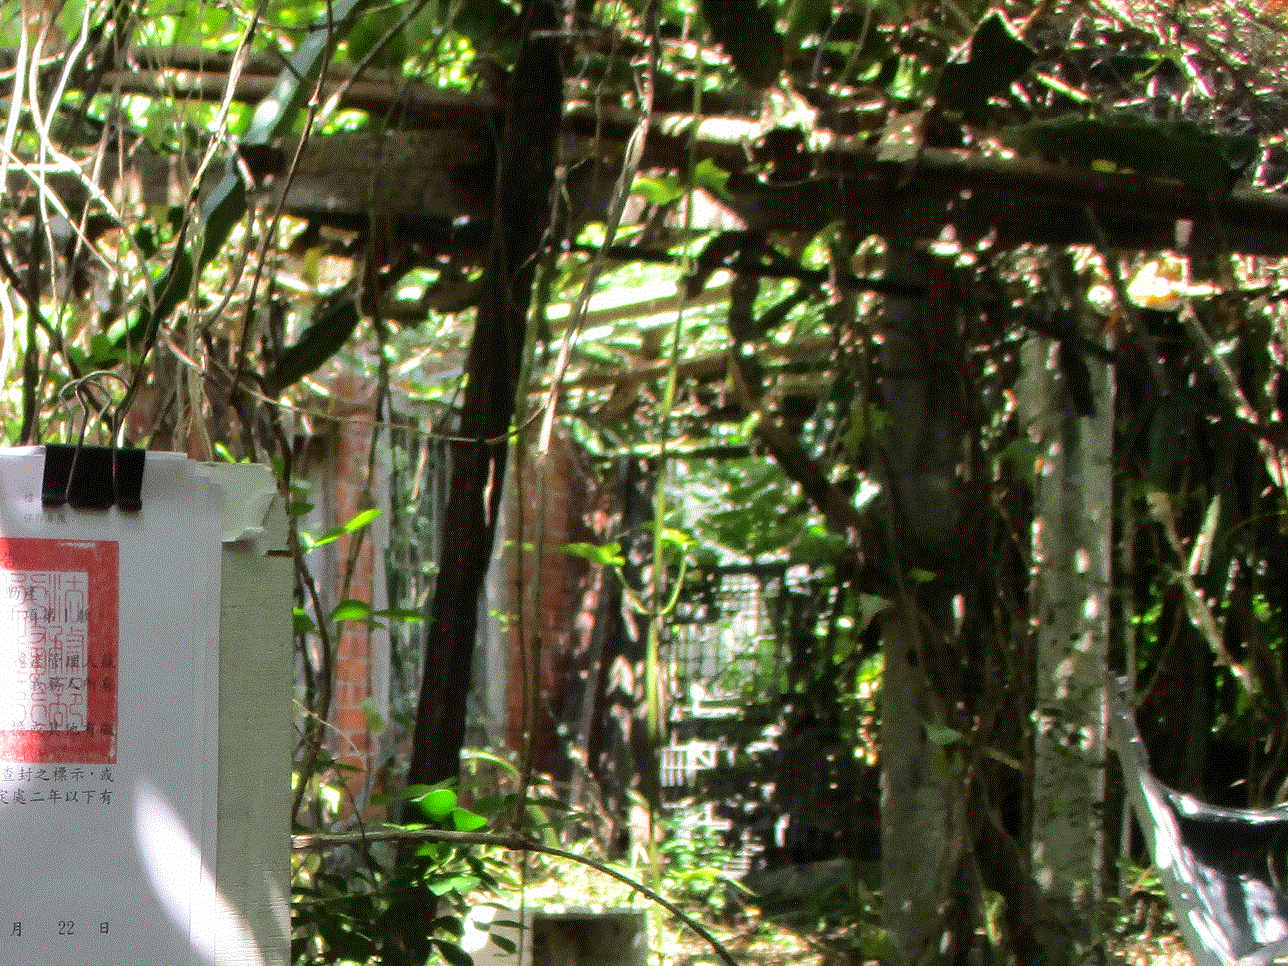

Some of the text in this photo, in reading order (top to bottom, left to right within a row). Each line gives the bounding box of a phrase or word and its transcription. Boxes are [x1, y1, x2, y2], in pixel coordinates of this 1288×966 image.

[10, 922, 24, 937] 月
[58, 921, 75, 936] 22
[99, 922, 111, 936] 日
